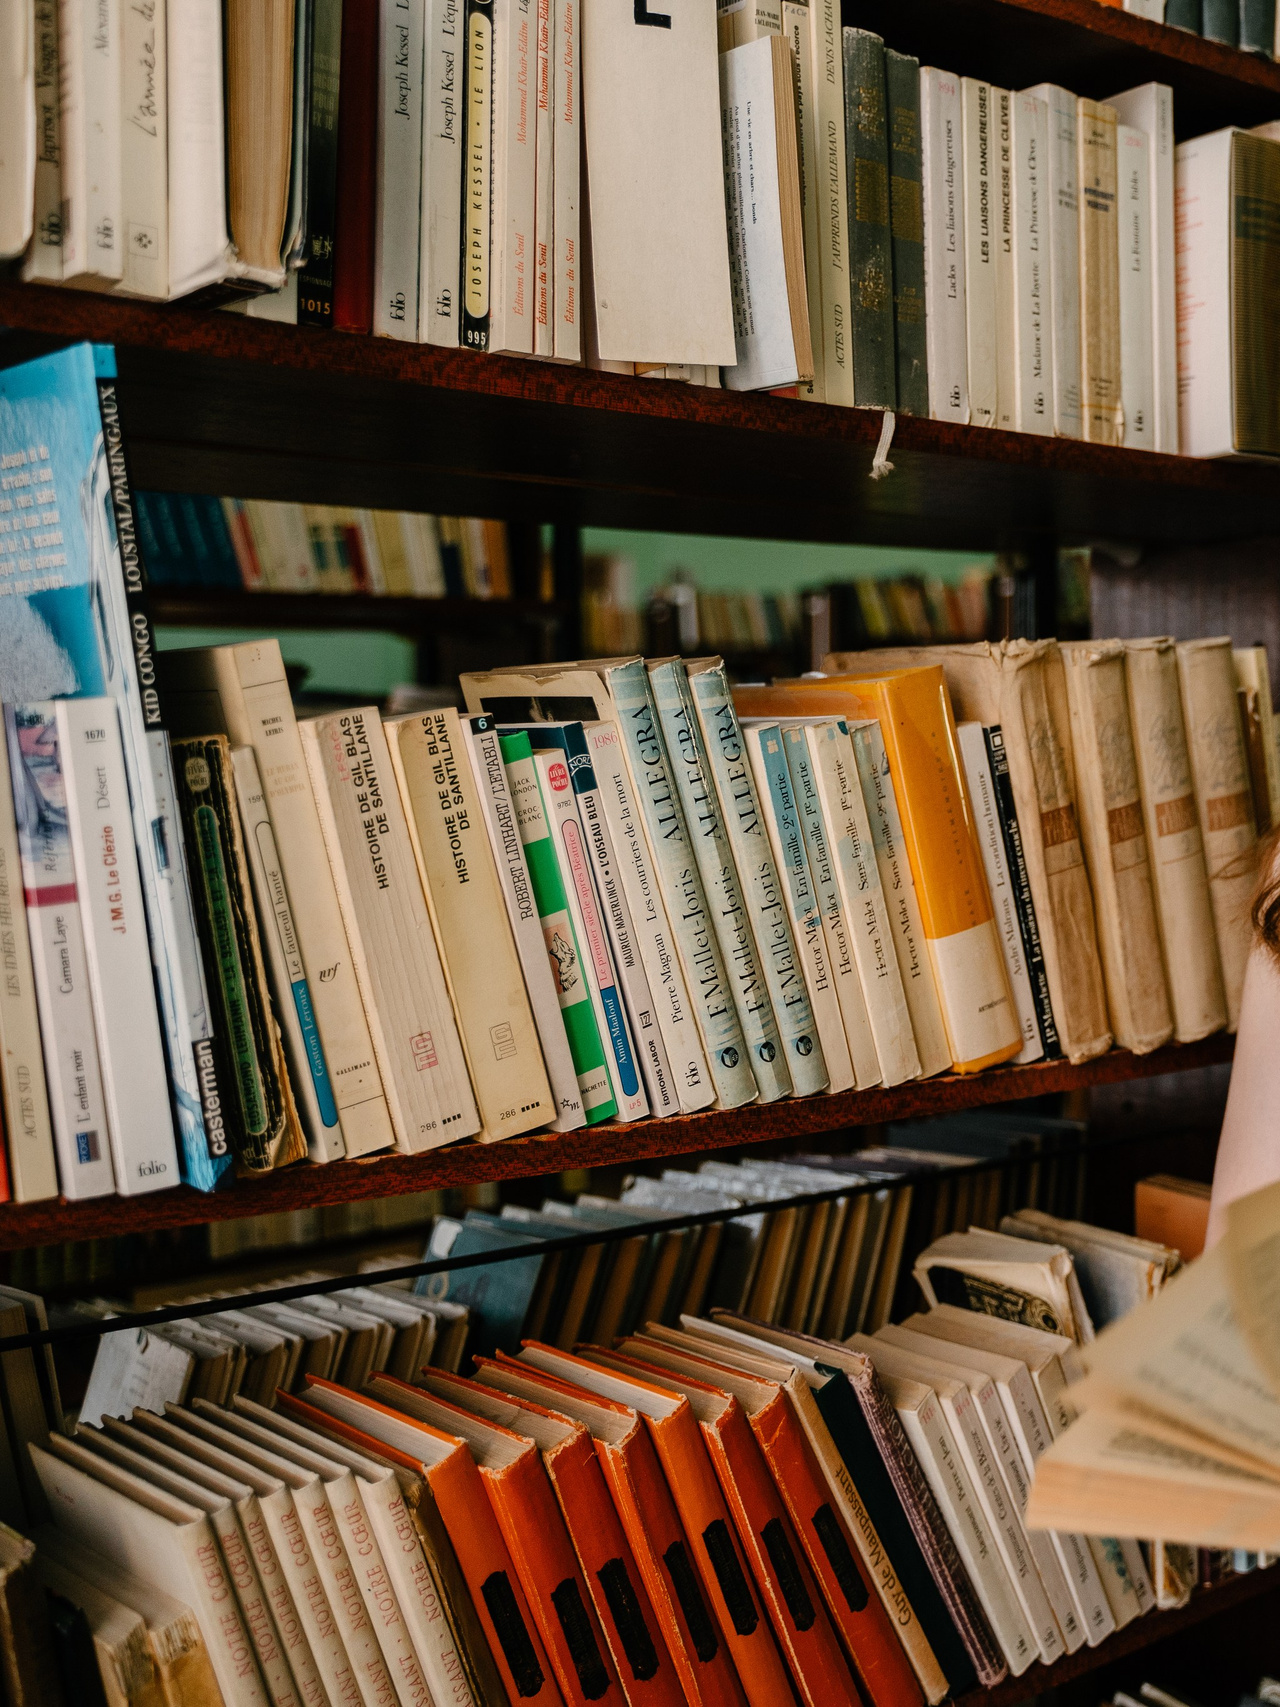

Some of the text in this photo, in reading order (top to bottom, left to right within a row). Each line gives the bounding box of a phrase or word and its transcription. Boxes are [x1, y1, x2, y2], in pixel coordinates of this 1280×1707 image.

[755, 9, 780, 21] JEAN-MARIE
[394, 27, 411, 120] Joseph Kessel
[538, 58, 549, 110] Mohammed
[564, 2, 574, 124] Mohammed Khaïr-Eddine
[824, 48, 835, 84] DENIS
[440, 50, 457, 143] Joseph Kessel
[517, 89, 528, 144] Mohammed
[472, 30, 483, 296] JOSEPH KESSEL LE LION
[747, 131, 751, 139] en
[1001, 145, 1010, 161] DE
[828, 120, 842, 269] J'APPRENDS L'ALLEMAND
[978, 86, 989, 263] LES LIAISONS DANGEREUSES
[1001, 166, 1010, 233] PRINCESSE
[945, 120, 956, 298] Laclos Les liaisons dangereuses
[1003, 238, 1010, 252] LA
[301, 298, 331, 315] 1015
[390, 292, 406, 321] folio
[436, 289, 451, 317] folio
[536, 243, 548, 324] Éditions du Seuil
[564, 238, 575, 323] Éditions du Seuil
[467, 330, 486, 345] 995
[834, 304, 845, 367] ACTES SUD
[130, 611, 161, 723] KID CONGO
[84, 729, 106, 741] 1670
[261, 716, 282, 726] MICHEL
[478, 717, 488, 730] 6
[593, 731, 618, 749] 1986
[94, 768, 111, 810] Désert
[352, 715, 389, 834] DE SANTILLANE
[434, 715, 470, 830] DE SANTILLANE
[511, 784, 538, 798] LONDON
[514, 778, 531, 789] JACK
[570, 756, 593, 770] NORD
[633, 704, 682, 841] ALLEGRA
[716, 704, 761, 836] ALLEGRA
[340, 716, 389, 889] HISTOIRE DE GIL BLAS
[422, 716, 470, 884] HISTOIRE DE GIL BLAS
[480, 736, 533, 920] ROBERT LINHART L'ETABLI
[518, 806, 540, 817] CROC-
[519, 813, 543, 826] BLANC
[556, 799, 573, 810] 9782
[584, 796, 598, 820] BLEU
[797, 762, 832, 883] En famille partie
[98, 824, 120, 886] Le Clézio
[591, 822, 610, 868] L'OISEAU
[612, 773, 657, 922] Les courriers de la mort
[775, 773, 809, 898] En famille partie
[567, 832, 608, 982] Le premier siècle après Béatrice
[1007, 819, 1041, 962] La position du tireur couché
[265, 871, 302, 975] Le fauteuil hanté
[618, 931, 635, 968] MAURICE
[803, 906, 828, 991] Hector Malot
[825, 893, 852, 975] Hector Malot
[898, 899, 921, 978] Hector Malot
[52, 916, 72, 994] Camara Laye
[320, 962, 341, 983] nrf
[654, 933, 684, 1023] Pierre Magnan
[71, 1048, 83, 1071] noir
[293, 987, 325, 1076] Gaston Leroux
[604, 999, 627, 1064] Amin Maalouf
[193, 1040, 228, 1156] casterman
[336, 1061, 371, 1076] GALLIMARD
[581, 1080, 607, 1095] HACHETTE
[648, 1039, 671, 1106] ÉDITIONS LABOR
[685, 1061, 701, 1087] folio
[500, 1108, 517, 1121] 286
[74, 1131, 91, 1164] POCKET
[138, 1159, 167, 1177] folio
[836, 1466, 912, 1627] Guy de Maupassant
[269, 1585, 303, 1646] NOTRE
[332, 1567, 367, 1629] NOTRE
[366, 1565, 400, 1626] NOTRE
[408, 1561, 442, 1621] NOTRE
[219, 1610, 255, 1674] NOTRE
[244, 1598, 279, 1662] NOTRE
